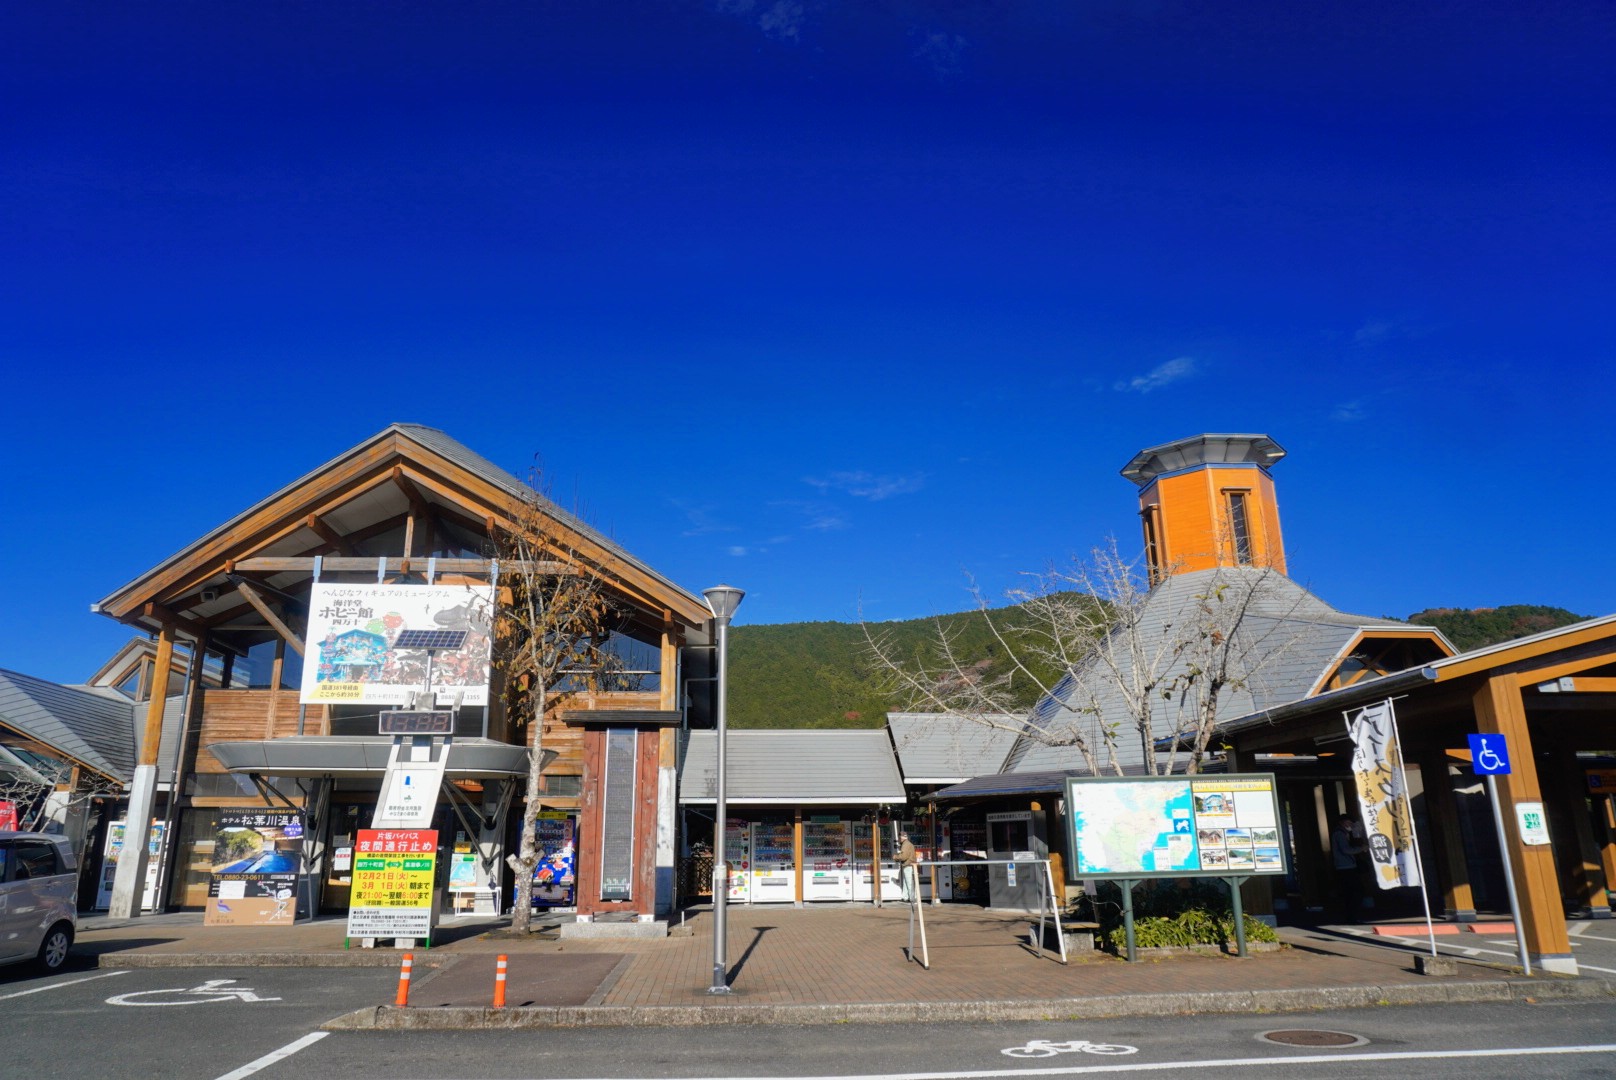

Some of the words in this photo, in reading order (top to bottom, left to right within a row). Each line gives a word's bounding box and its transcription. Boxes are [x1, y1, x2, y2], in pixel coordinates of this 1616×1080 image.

[333, 599, 363, 607] 海洋堂
[319, 607, 374, 618] ホビー館
[331, 618, 362, 626] 四万十
[241, 815, 301, 826] 松葉川温泉
[376, 832, 419, 840] 片坂バイパス
[360, 840, 433, 852] 夜間通行止め
